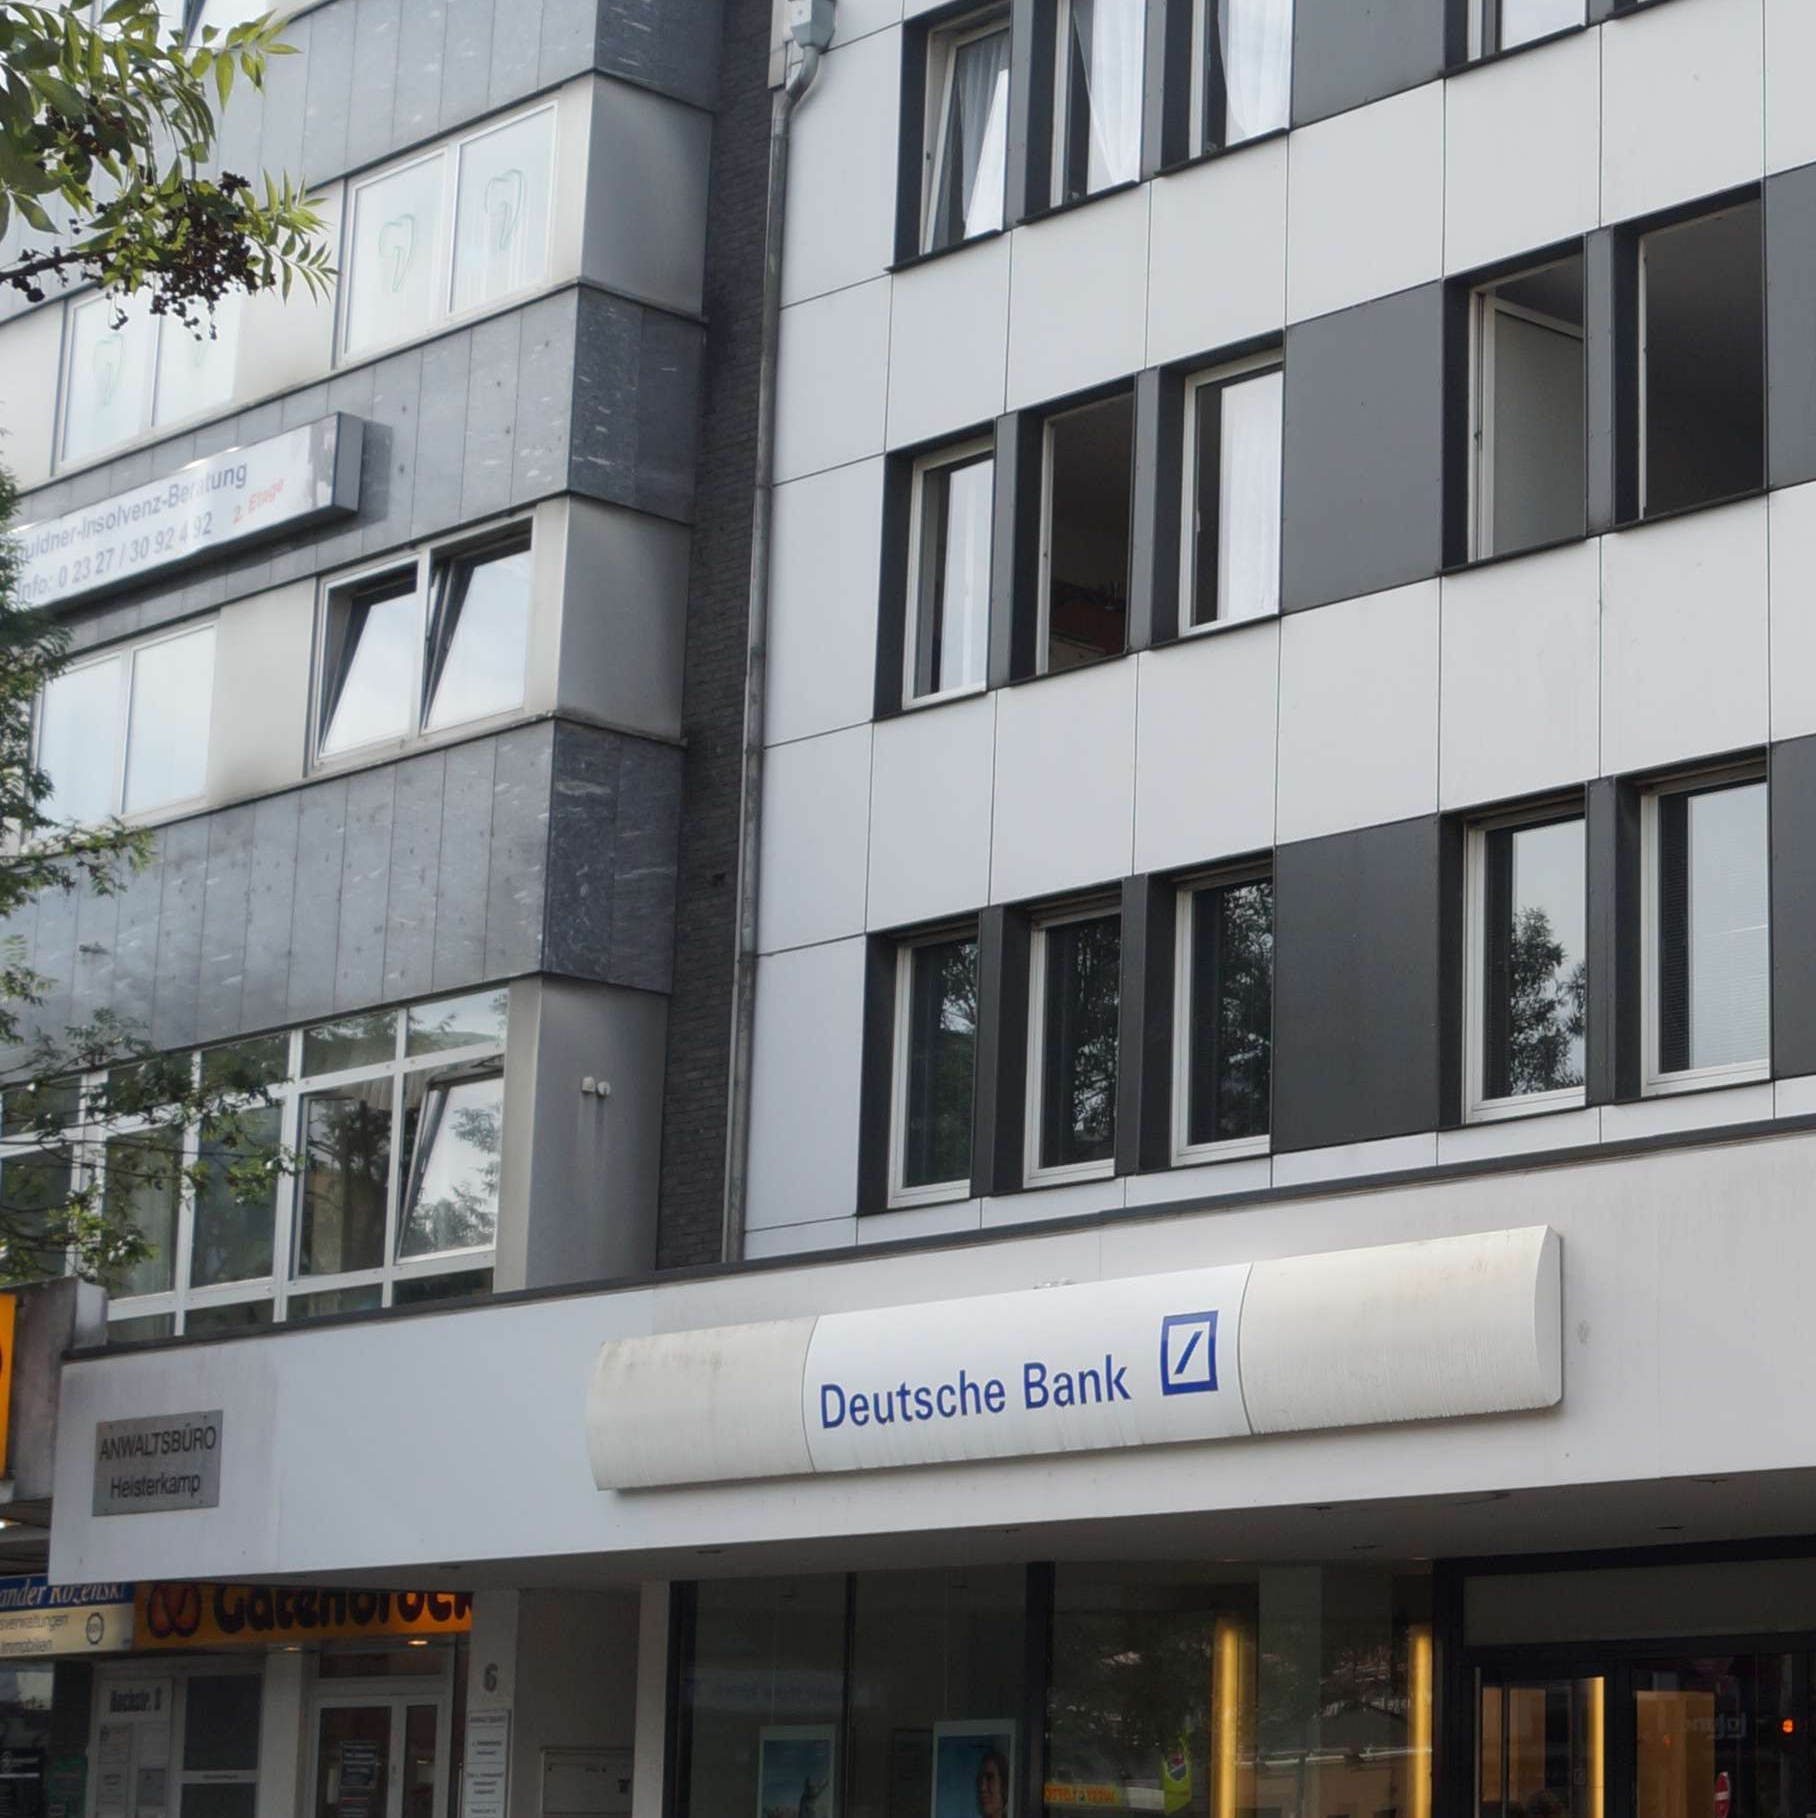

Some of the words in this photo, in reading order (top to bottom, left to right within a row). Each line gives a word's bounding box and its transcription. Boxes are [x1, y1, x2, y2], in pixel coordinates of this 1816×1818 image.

[20, 463, 248, 560] uldner-Insolvenz-Beratung
[95, 547, 115, 574] 27
[129, 536, 149, 563] 30
[821, 1369, 1006, 1429] Deutsche
[1023, 1354, 1132, 1410] Bank
[101, 1423, 216, 1460] ANWALTSBÜRO
[110, 1473, 200, 1498] Heisterkamp
[483, 1663, 498, 1692] 6
